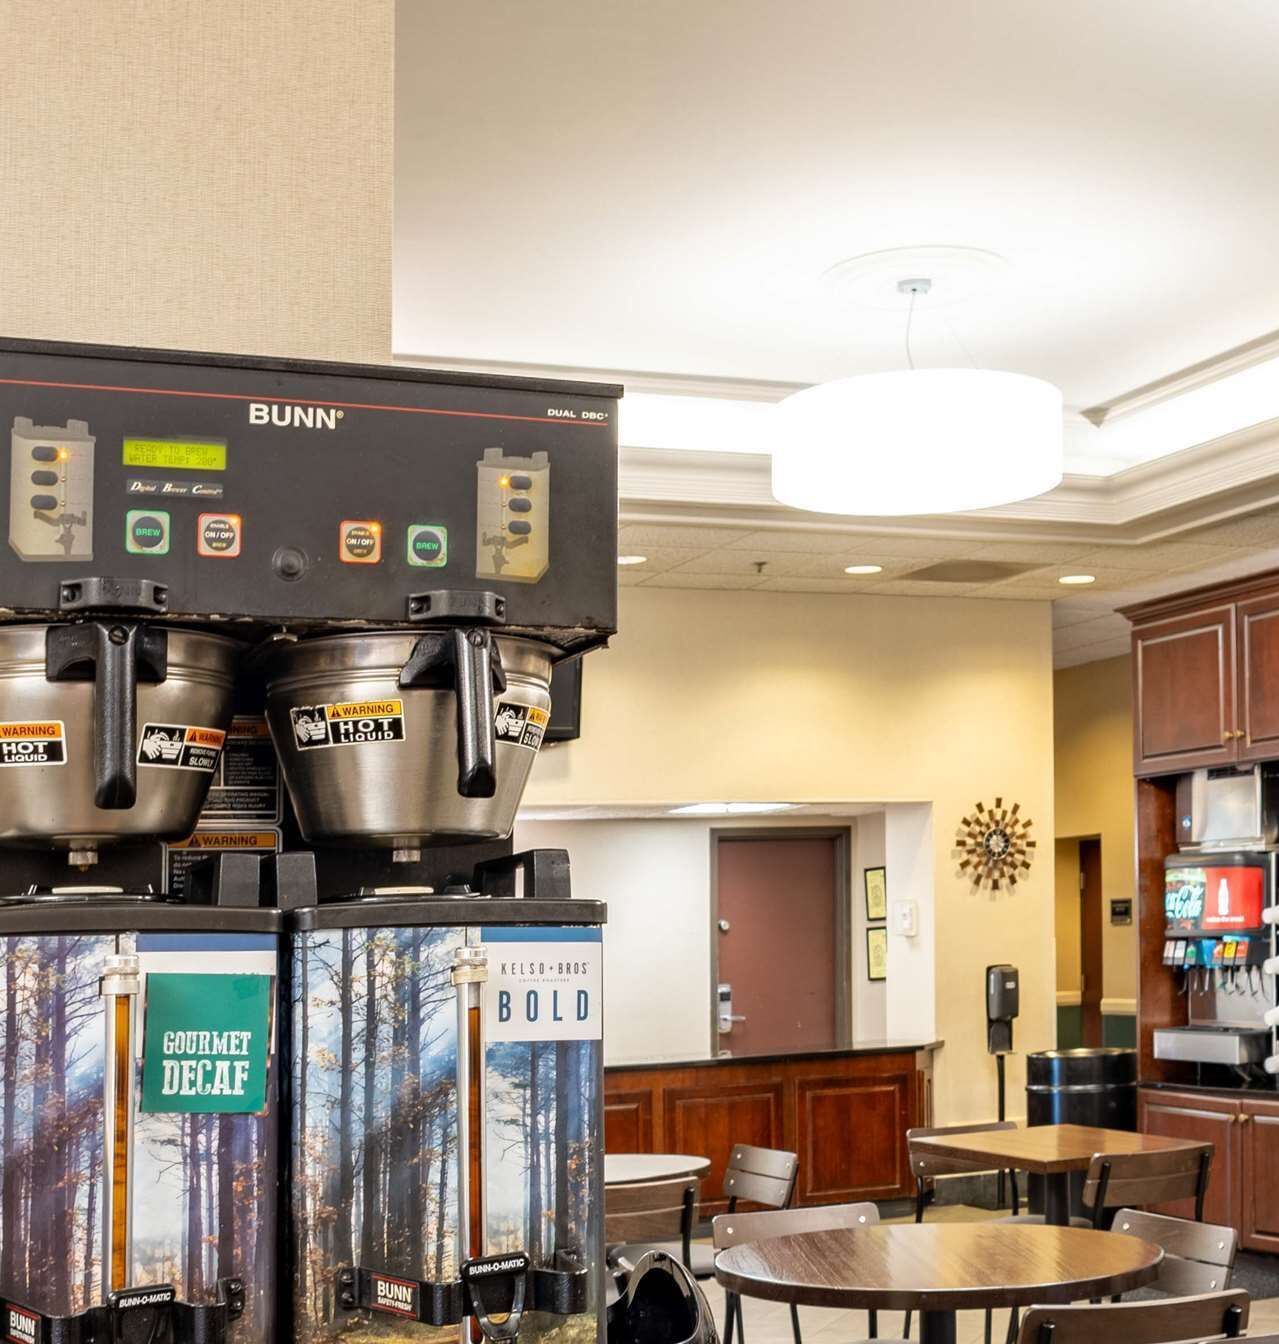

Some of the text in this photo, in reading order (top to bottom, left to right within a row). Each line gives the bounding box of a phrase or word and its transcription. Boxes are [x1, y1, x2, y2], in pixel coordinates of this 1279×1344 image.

[547, 408, 576, 418] DUAL
[134, 444, 164, 455] READY
[185, 447, 208, 457] BREW
[129, 454, 157, 464] WATER
[135, 527, 161, 537] BREW
[415, 542, 439, 551] BREW
[342, 704, 394, 715] WARNING
[2, 725, 56, 737] WARNING
[338, 718, 394, 734] HOT
[340, 731, 394, 743] LIQUID
[2, 741, 49, 755] HOT
[4, 753, 48, 764] LIQUID
[203, 836, 257, 846] WARNING
[501, 962, 545, 976] KELSO
[498, 989, 589, 1023] BOLD
[163, 1030, 252, 1056] GOURMET
[162, 1059, 250, 1096] DECAF
[470, 1258, 525, 1275] BUNN-O-MATIC
[377, 1280, 412, 1304] BUNN
[119, 1291, 172, 1309] BUNN-O-MATIC
[9, 1311, 36, 1338] BUNN
